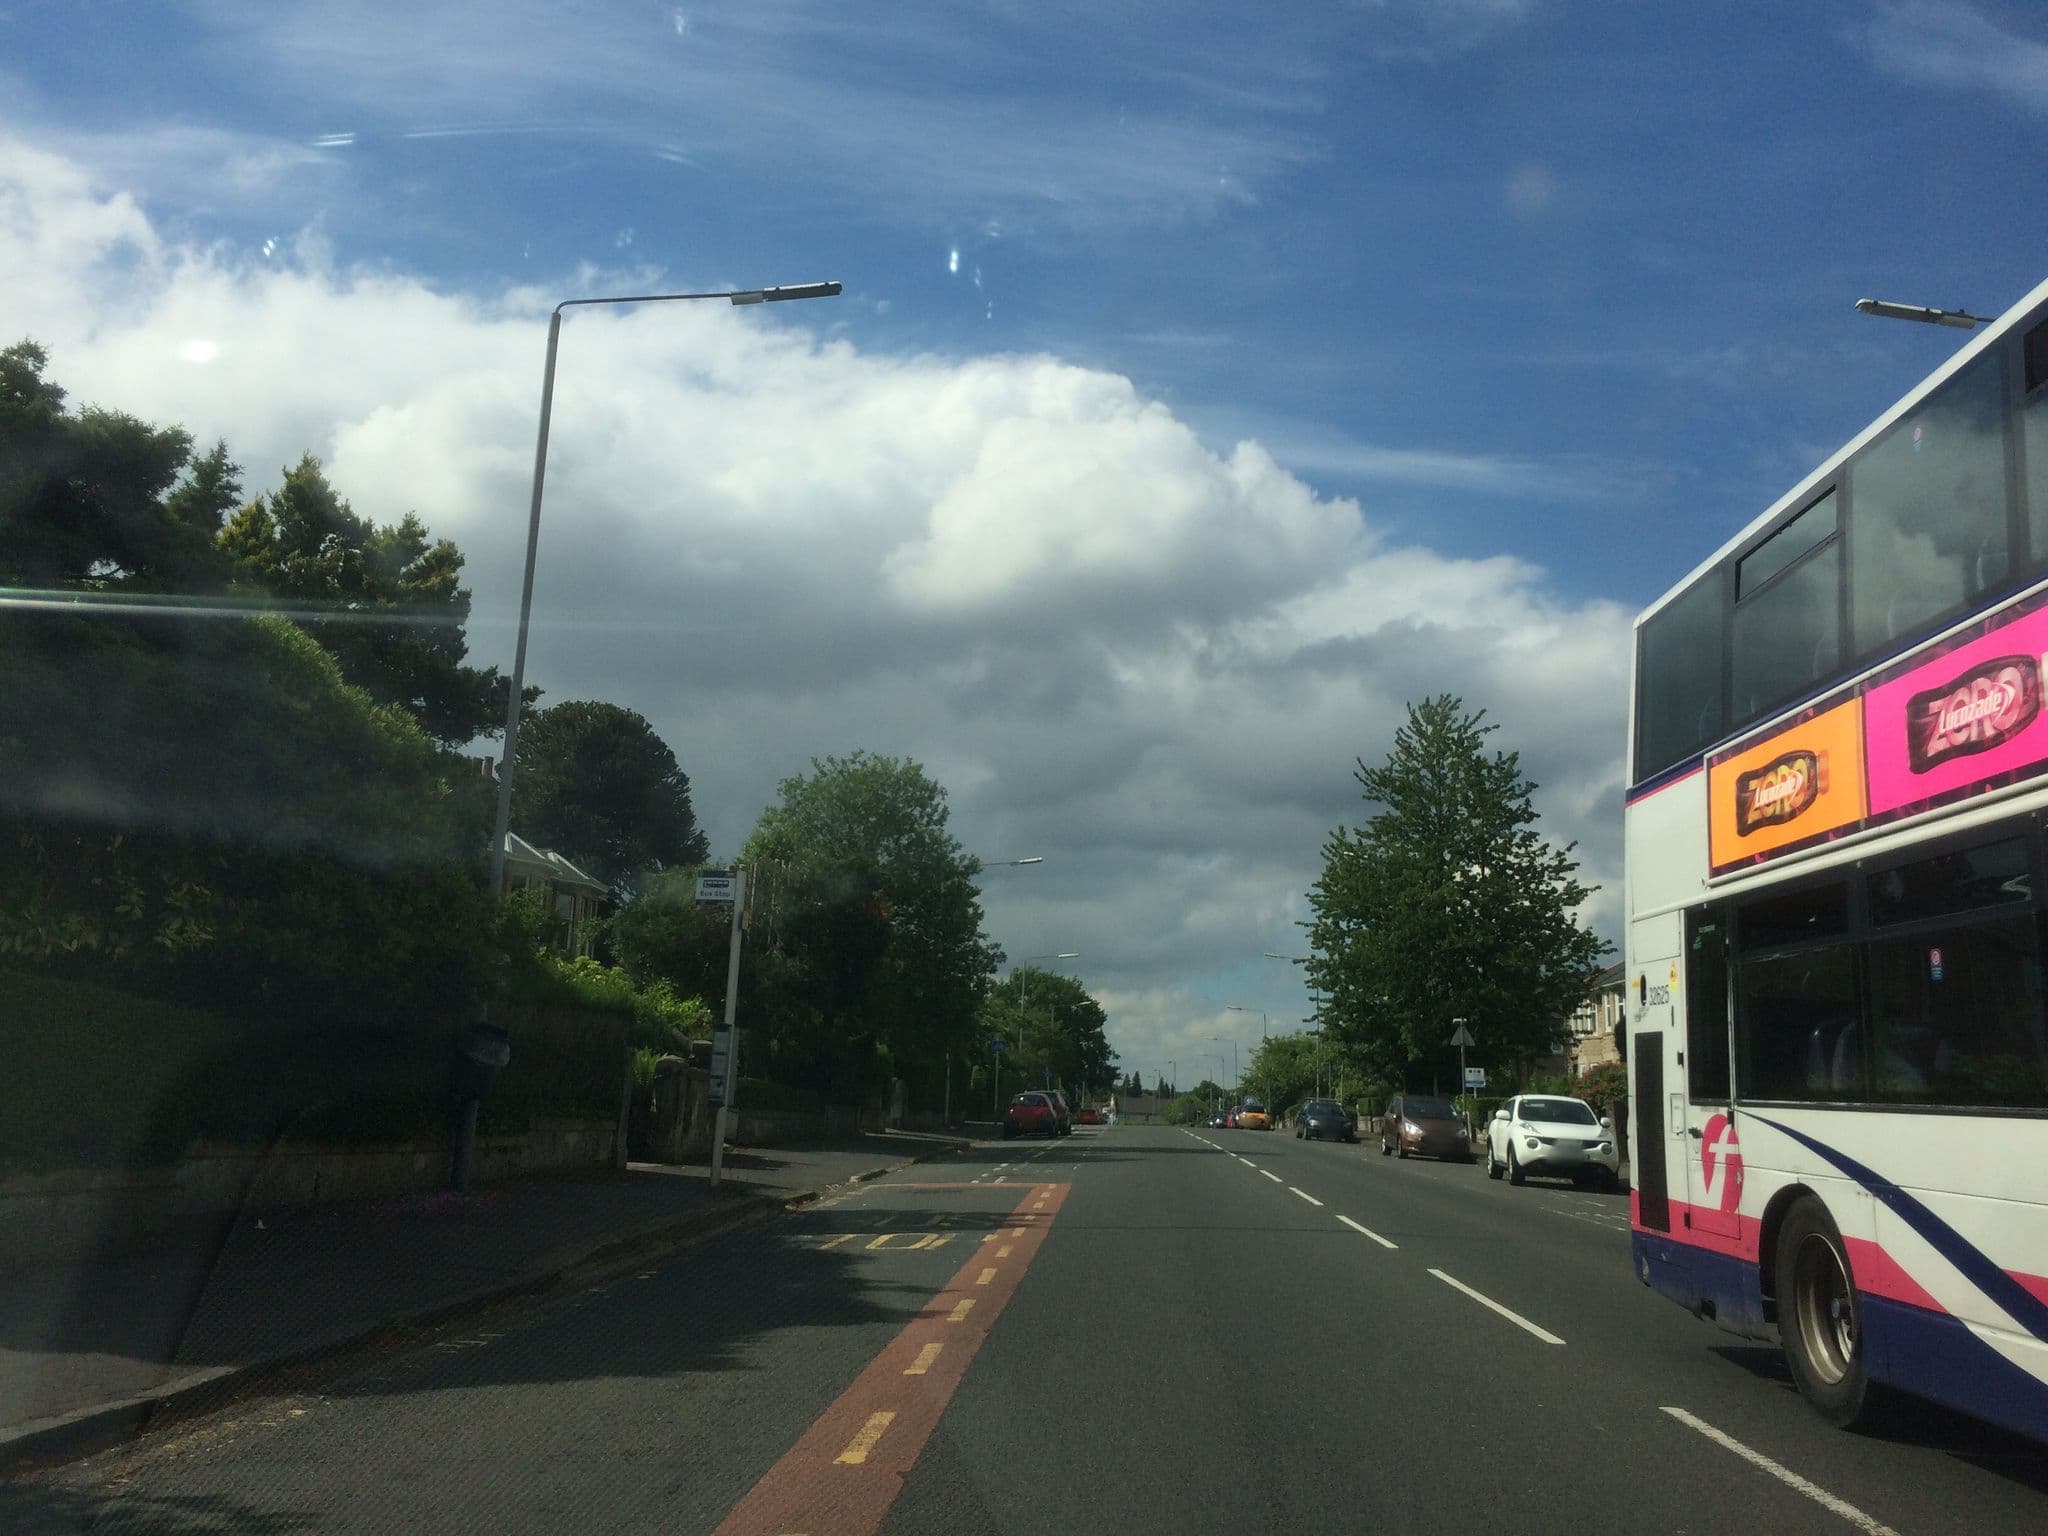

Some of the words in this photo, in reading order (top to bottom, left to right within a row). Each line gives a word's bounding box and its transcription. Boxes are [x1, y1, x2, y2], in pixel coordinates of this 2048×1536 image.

[1938, 691, 2003, 739] Lucozade
[713, 890, 731, 898] Stop
[1649, 984, 1670, 1006] 32625
